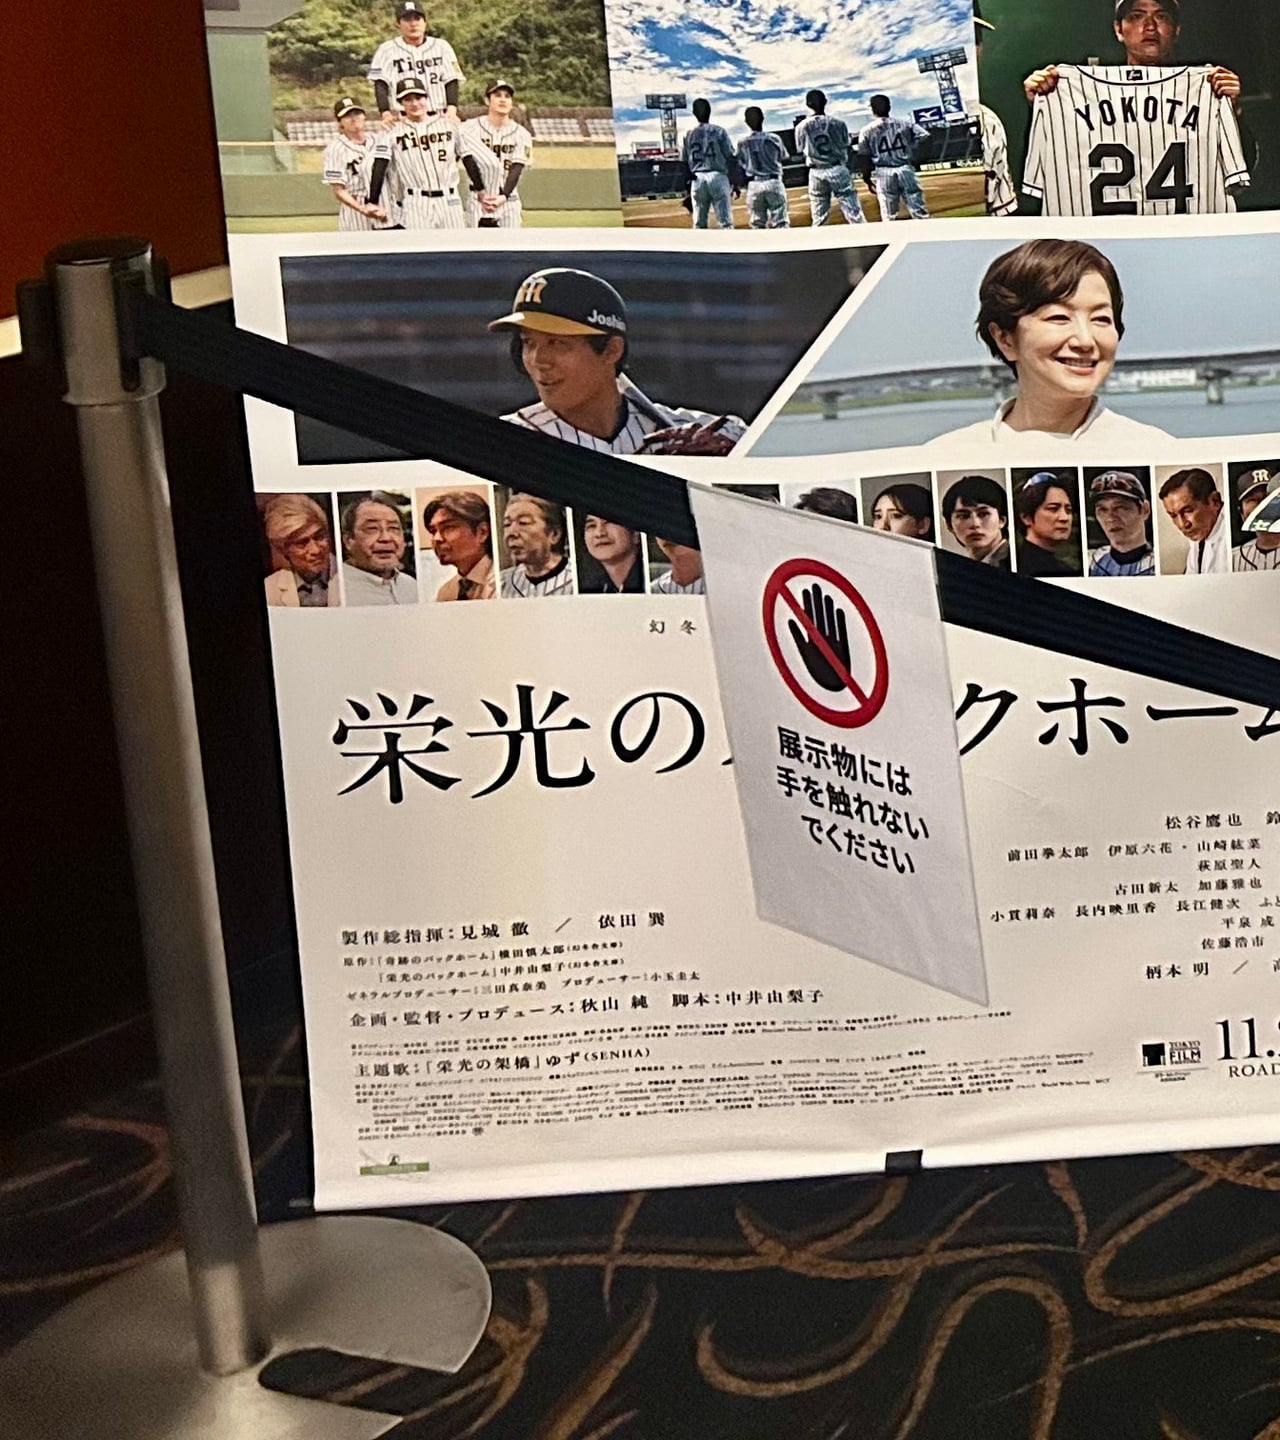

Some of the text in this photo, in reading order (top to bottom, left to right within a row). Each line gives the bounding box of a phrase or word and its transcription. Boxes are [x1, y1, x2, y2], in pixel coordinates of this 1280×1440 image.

[1075, 95, 1201, 133] YOKOTA
[396, 130, 453, 152] Tigers
[690, 140, 716, 163] 24
[813, 134, 828, 158] 2
[877, 134, 906, 156] 44
[437, 149, 447, 162] 2
[1088, 141, 1195, 216] 24
[777, 726, 913, 797] 展示物には
[776, 765, 930, 842] 手を触れない
[1165, 812, 1243, 831] 松谷鷹也
[800, 813, 916, 875] でください
[1007, 844, 1090, 862] 前田拳太郎
[1113, 879, 1180, 896] 古田新太
[1198, 875, 1263, 892] 加藤雅也
[1169, 1049, 1202, 1061] FILM
